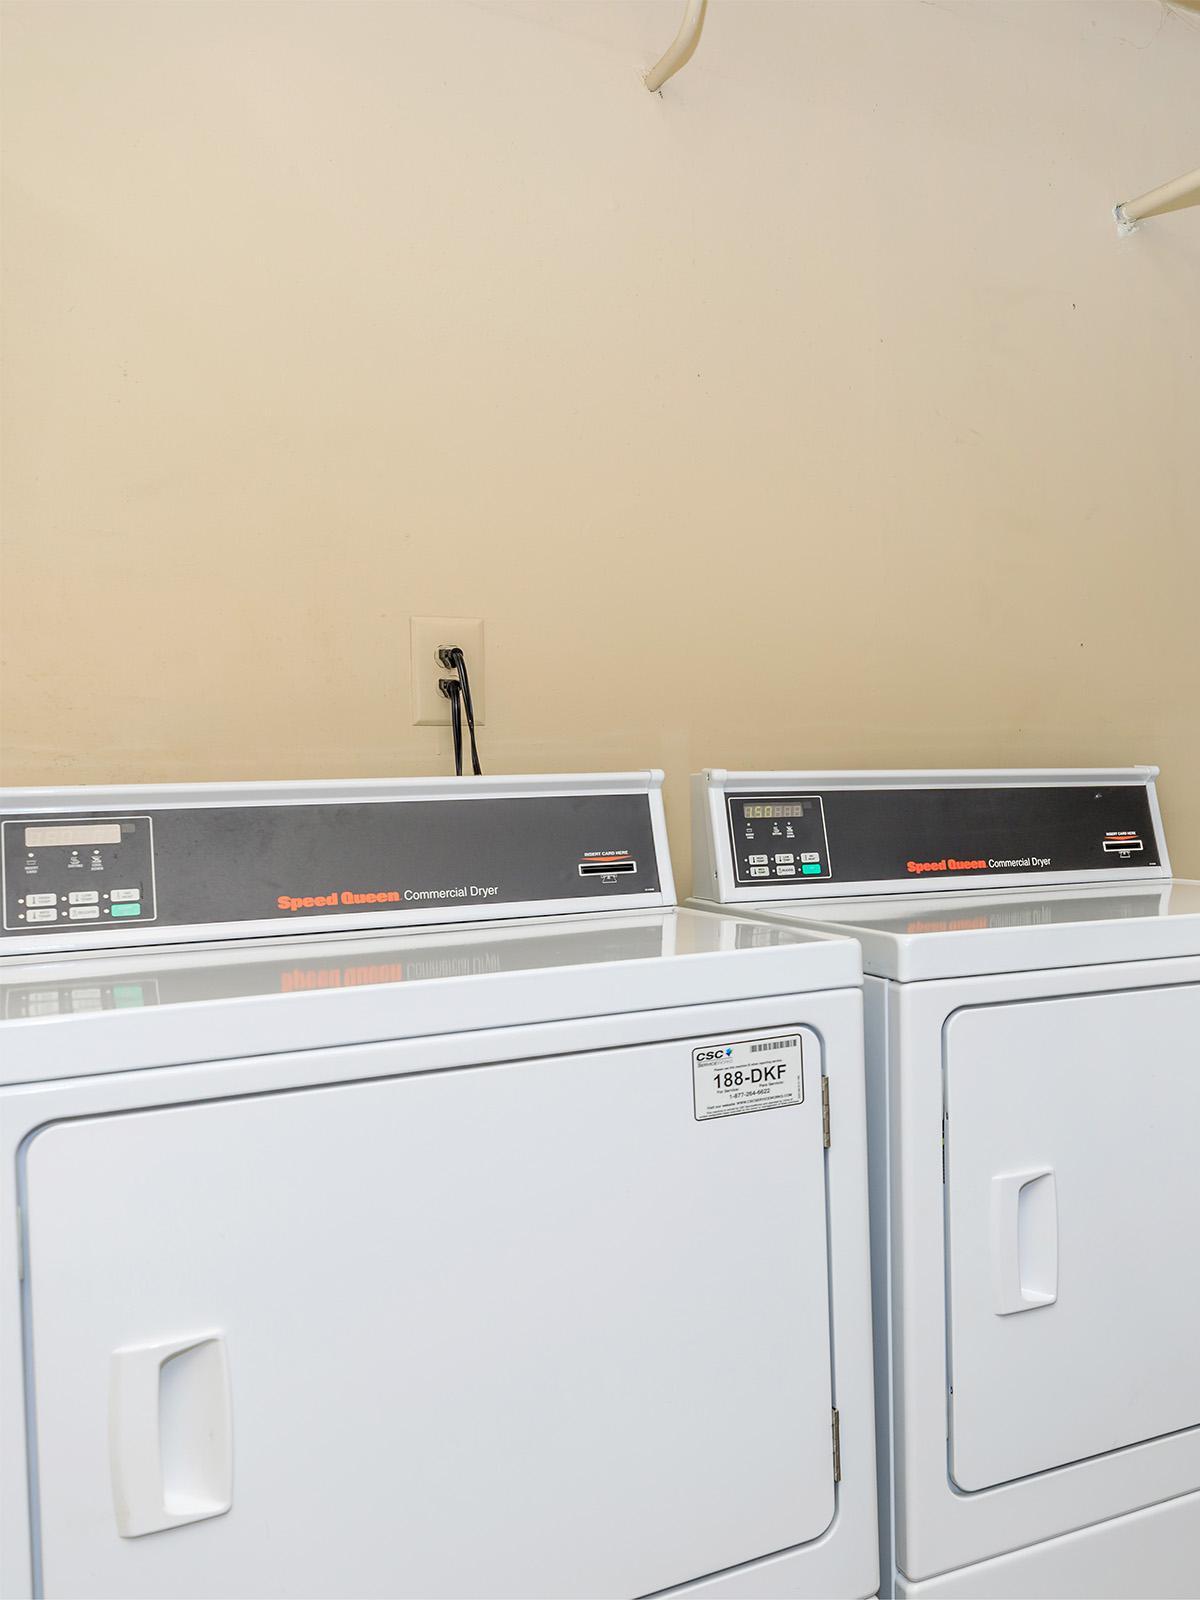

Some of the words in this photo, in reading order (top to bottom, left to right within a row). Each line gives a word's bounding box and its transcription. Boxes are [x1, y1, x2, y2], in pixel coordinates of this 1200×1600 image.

[907, 859, 947, 874] Speed
[948, 858, 987, 870] Queen
[988, 857, 1031, 868] Commercial
[1031, 857, 1051, 867] Dryer
[277, 892, 339, 911] Speed
[341, 890, 400, 905] Queen
[404, 886, 468, 901] Commercial
[470, 885, 499, 898] Dryer
[696, 1050, 724, 1062] CSC
[713, 1064, 787, 1089] 188-DKF
